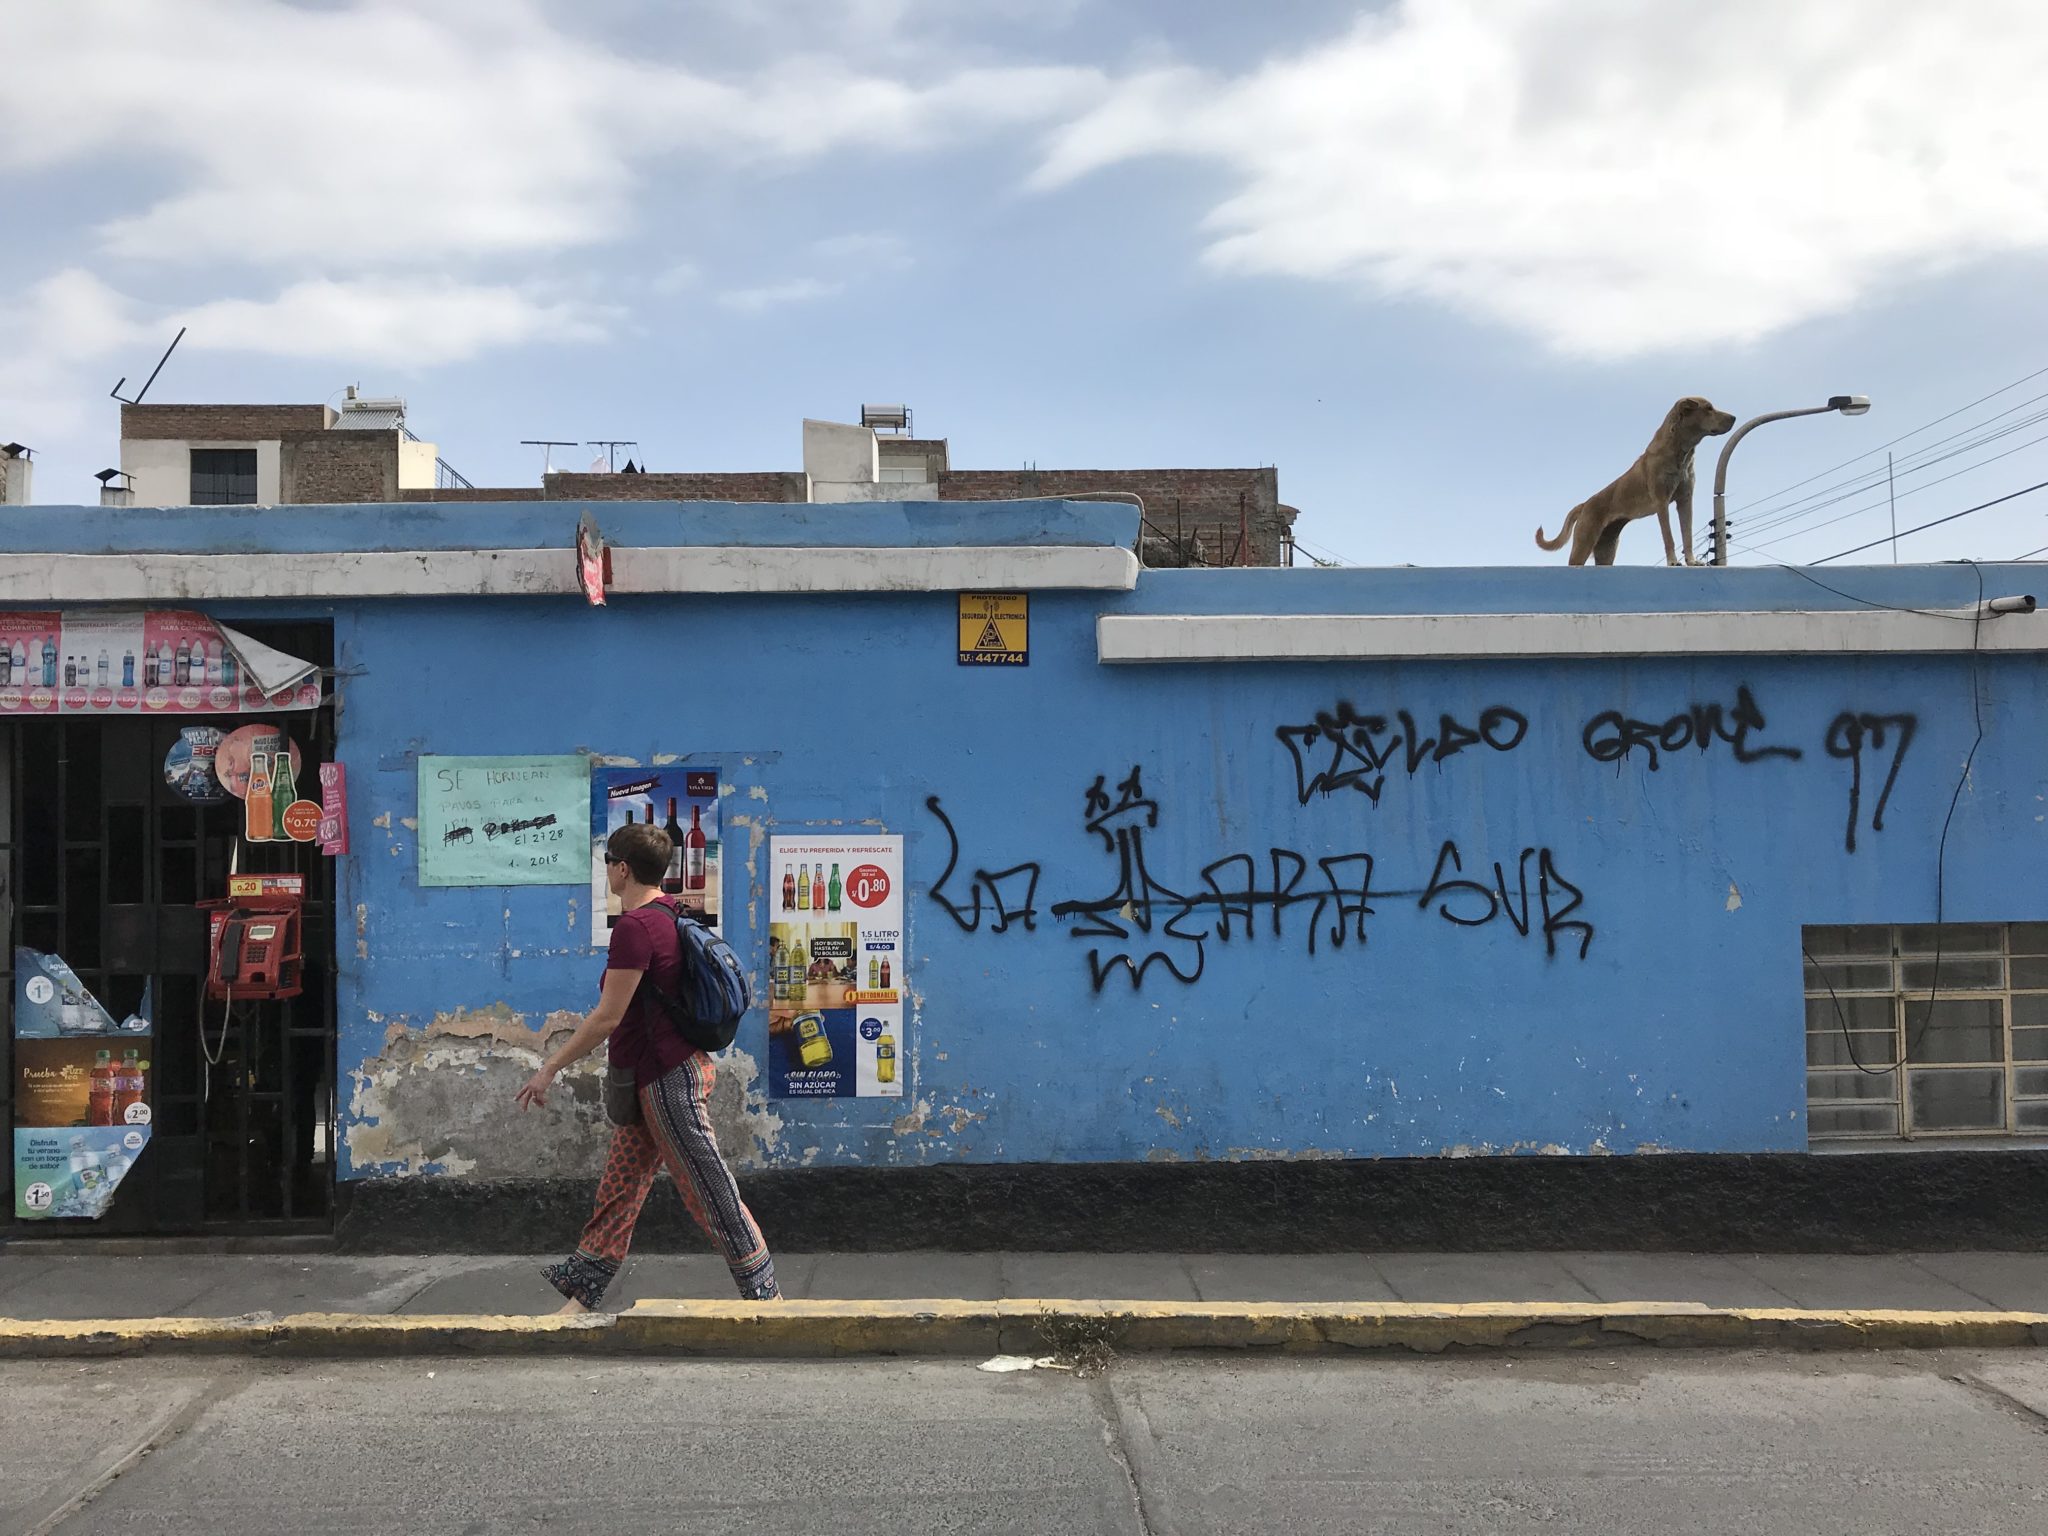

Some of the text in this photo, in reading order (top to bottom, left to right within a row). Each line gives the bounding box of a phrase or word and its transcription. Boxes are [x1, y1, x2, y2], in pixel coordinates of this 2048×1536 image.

[975, 653, 1024, 663] 447744
[437, 769, 549, 792] SE HORNEAN
[530, 853, 559, 867] 2018
[237, 882, 257, 892] 0.20
[874, 930, 900, 938] LITRO
[23, 1067, 57, 1079] Prueba
[803, 1080, 836, 1089] AZÚCAR
